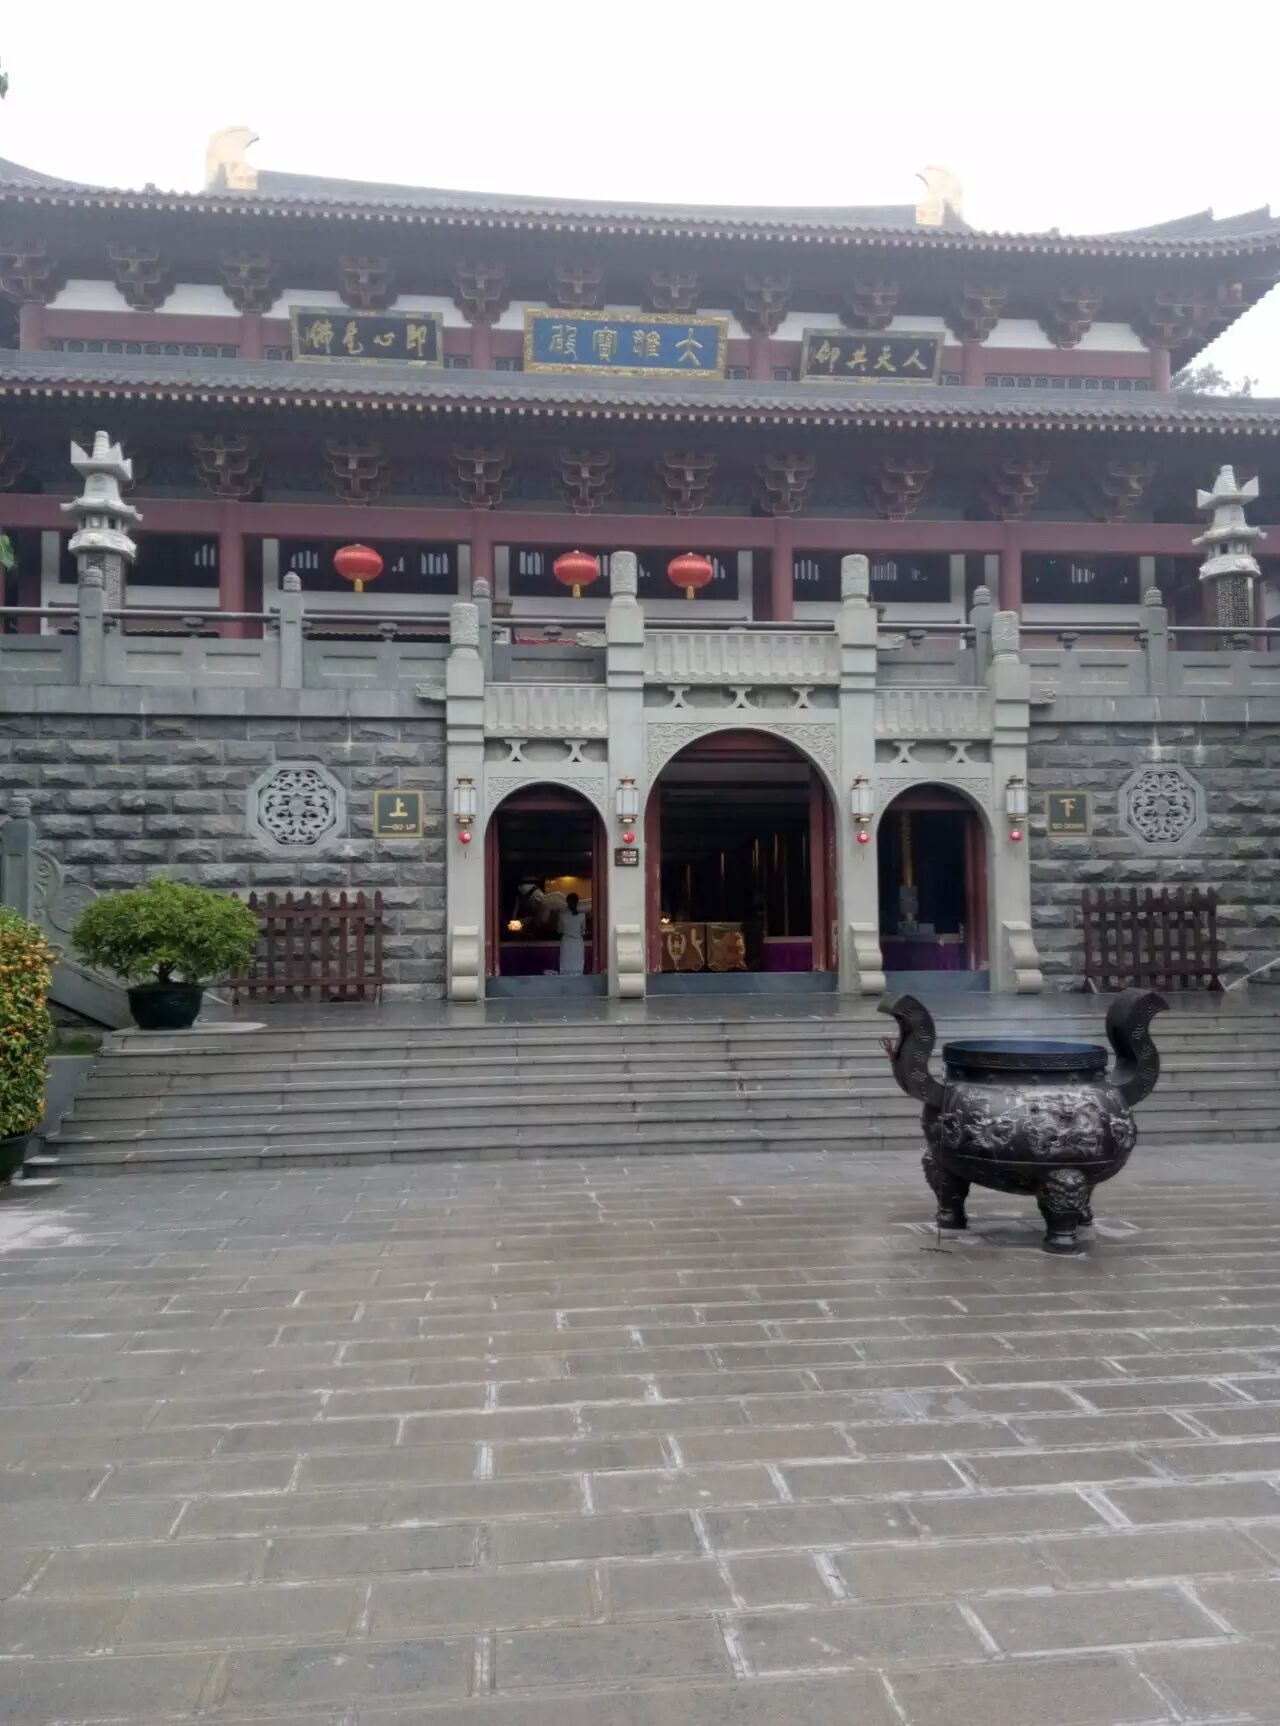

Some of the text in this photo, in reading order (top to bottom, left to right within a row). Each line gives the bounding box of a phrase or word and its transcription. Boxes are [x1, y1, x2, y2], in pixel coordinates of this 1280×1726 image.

[548, 323, 703, 368] 大雄寶殿
[388, 796, 409, 817] 上
[1059, 797, 1077, 818] 下
